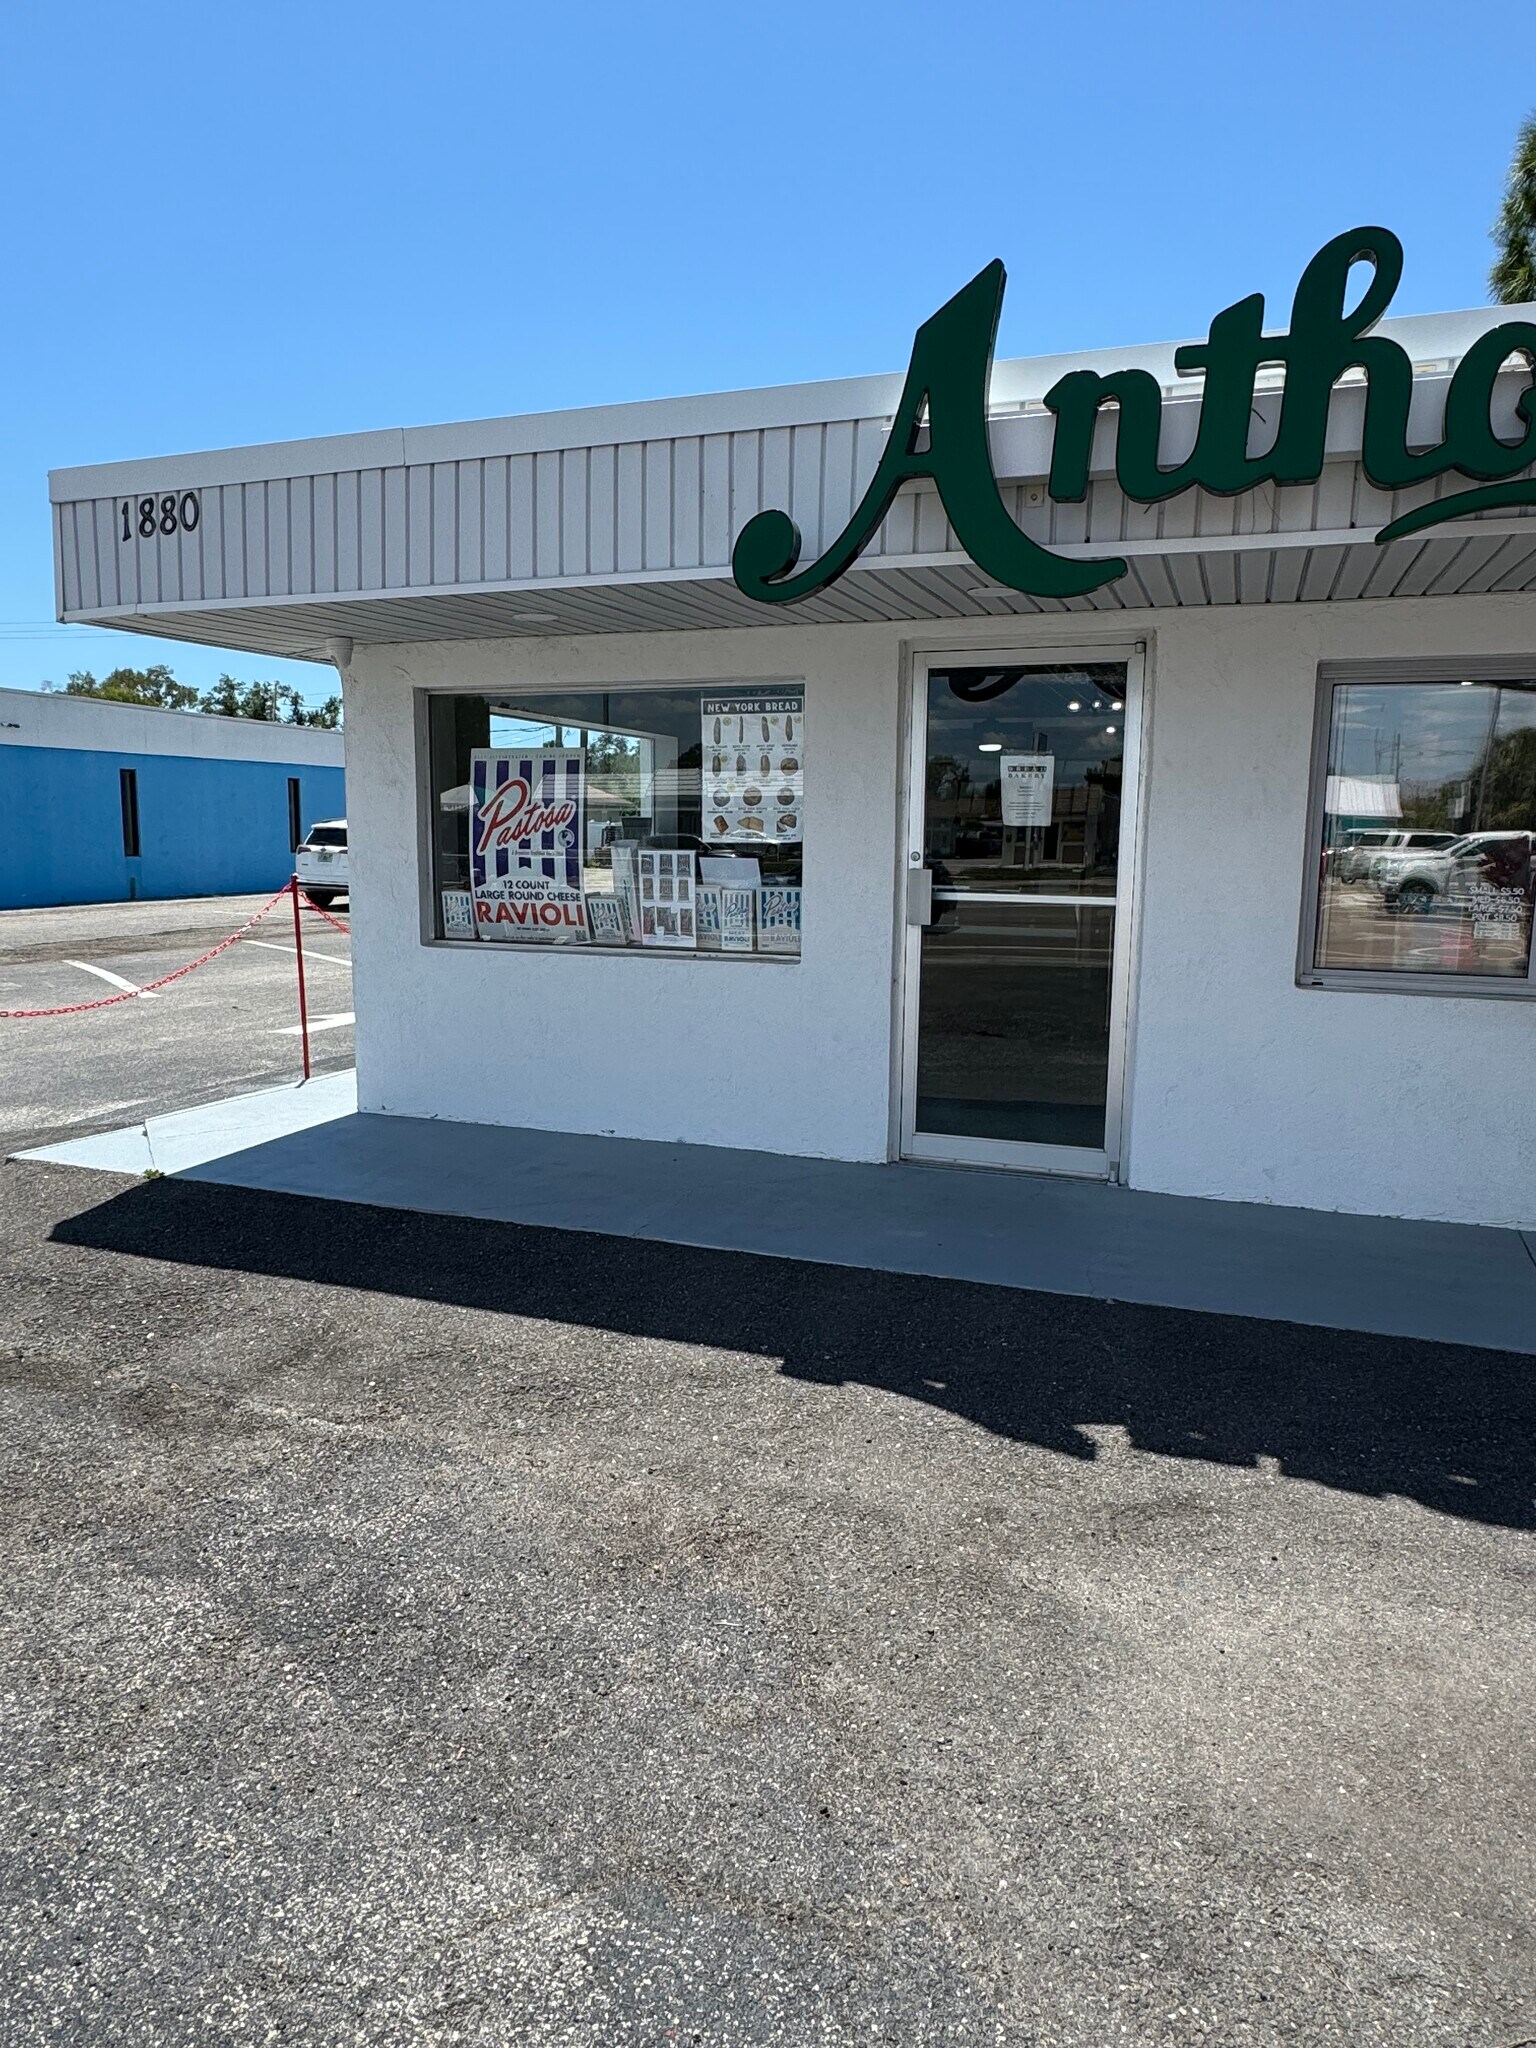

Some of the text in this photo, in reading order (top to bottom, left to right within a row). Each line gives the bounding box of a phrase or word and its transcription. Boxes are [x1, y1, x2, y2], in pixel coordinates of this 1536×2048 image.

[121, 491, 199, 542] 1880
[707, 701, 798, 713] NEW YORK BREAD
[479, 779, 574, 853] Pastosa
[503, 880, 550, 890] 12 COUNT
[475, 890, 581, 902] LARGE ROUND CHEESE
[476, 901, 585, 927] RAVIOLI
